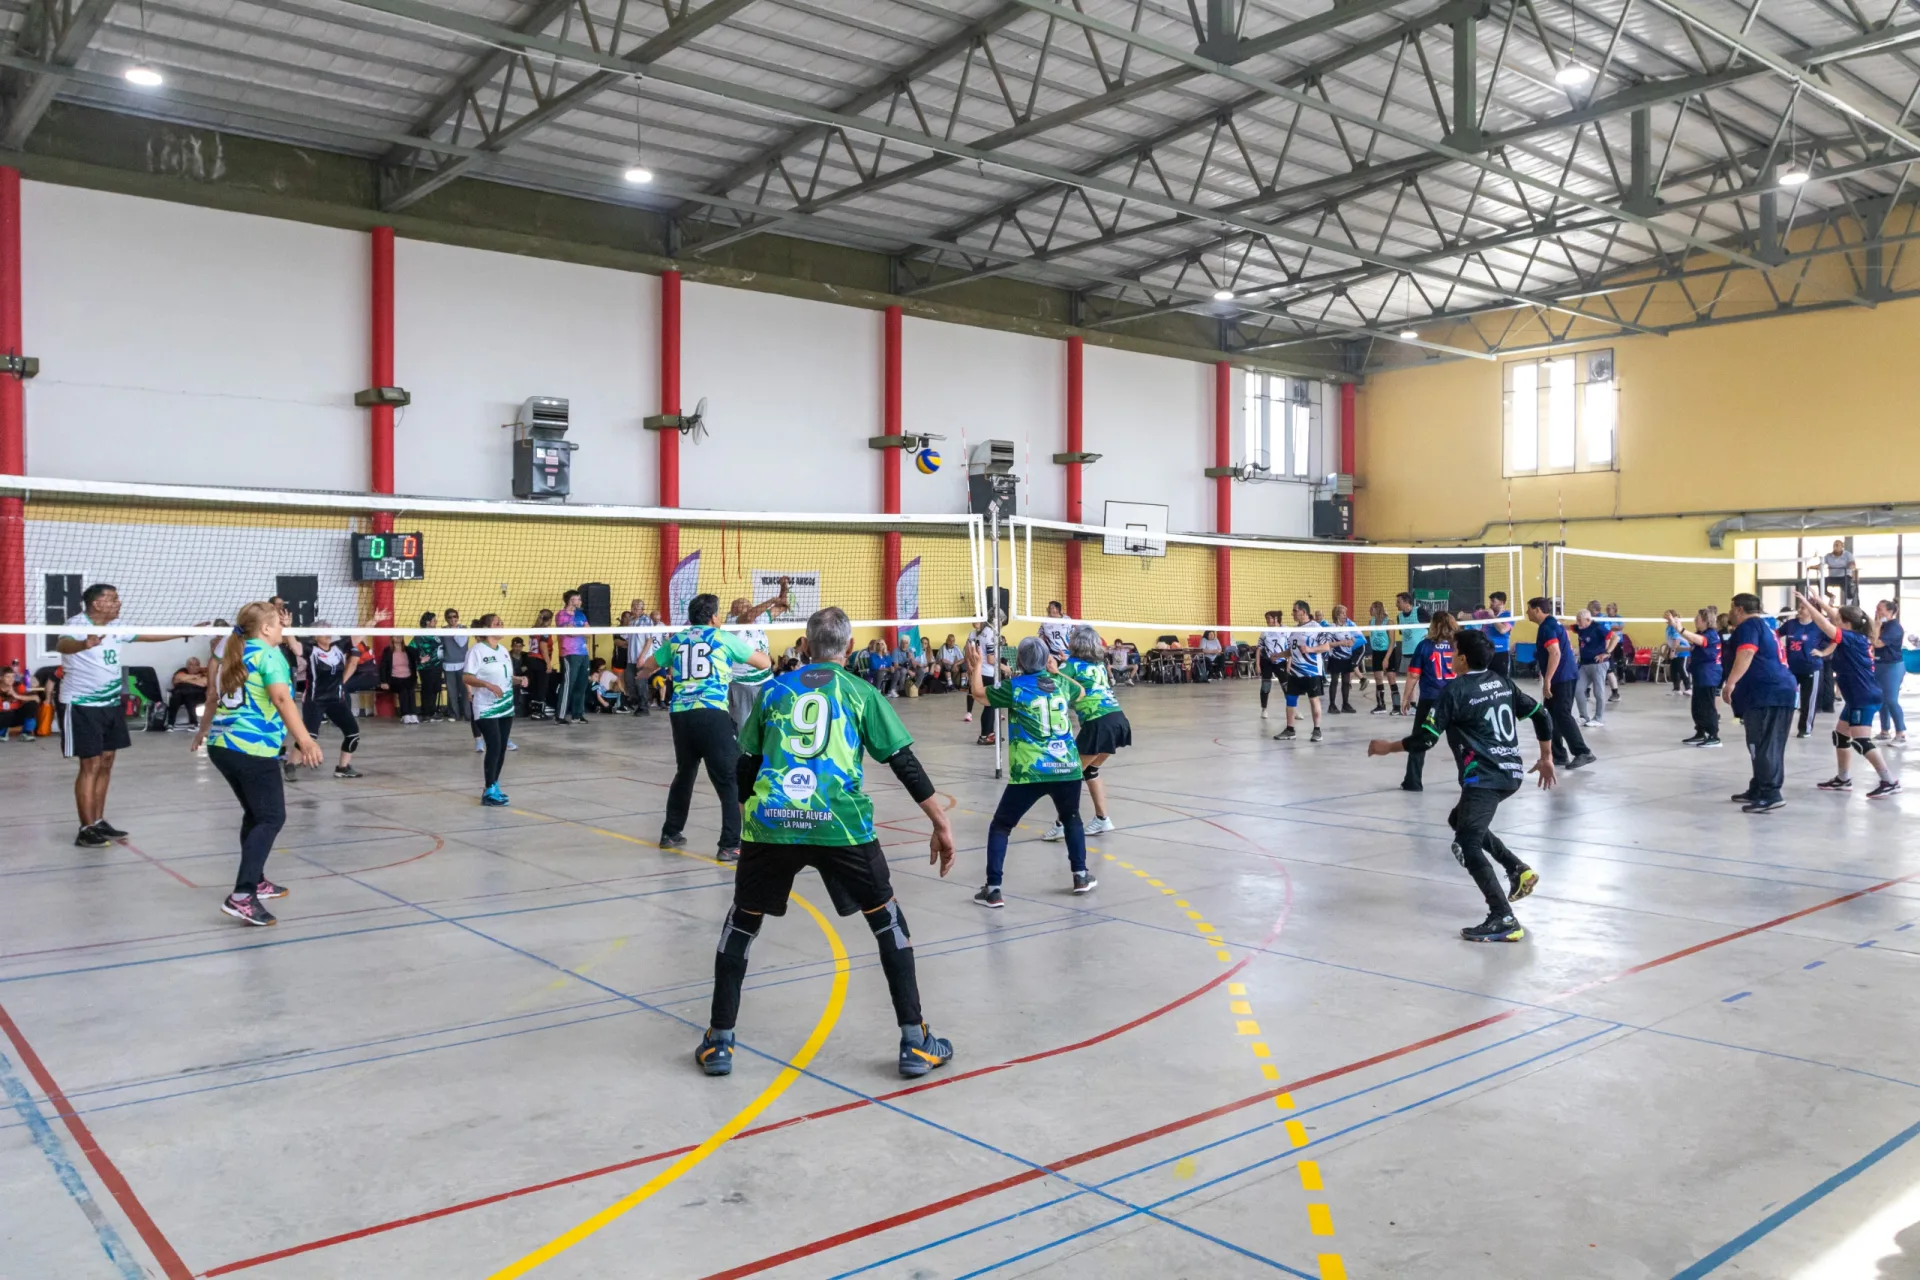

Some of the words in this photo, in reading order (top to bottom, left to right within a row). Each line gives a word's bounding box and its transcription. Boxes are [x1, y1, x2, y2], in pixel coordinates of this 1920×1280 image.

[370, 537, 385, 559] 0
[403, 537, 417, 557] 0
[375, 559, 415, 580] 4:30
[676, 641, 713, 681] 16
[790, 693, 831, 759] 9
[1031, 695, 1070, 738] 13
[1484, 703, 1516, 742] 10
[790, 773, 811, 785] GN
[764, 808, 804, 819] INTENDENTE
[805, 809, 833, 821] ALVEAR
[792, 822, 813, 830] PAMPA
